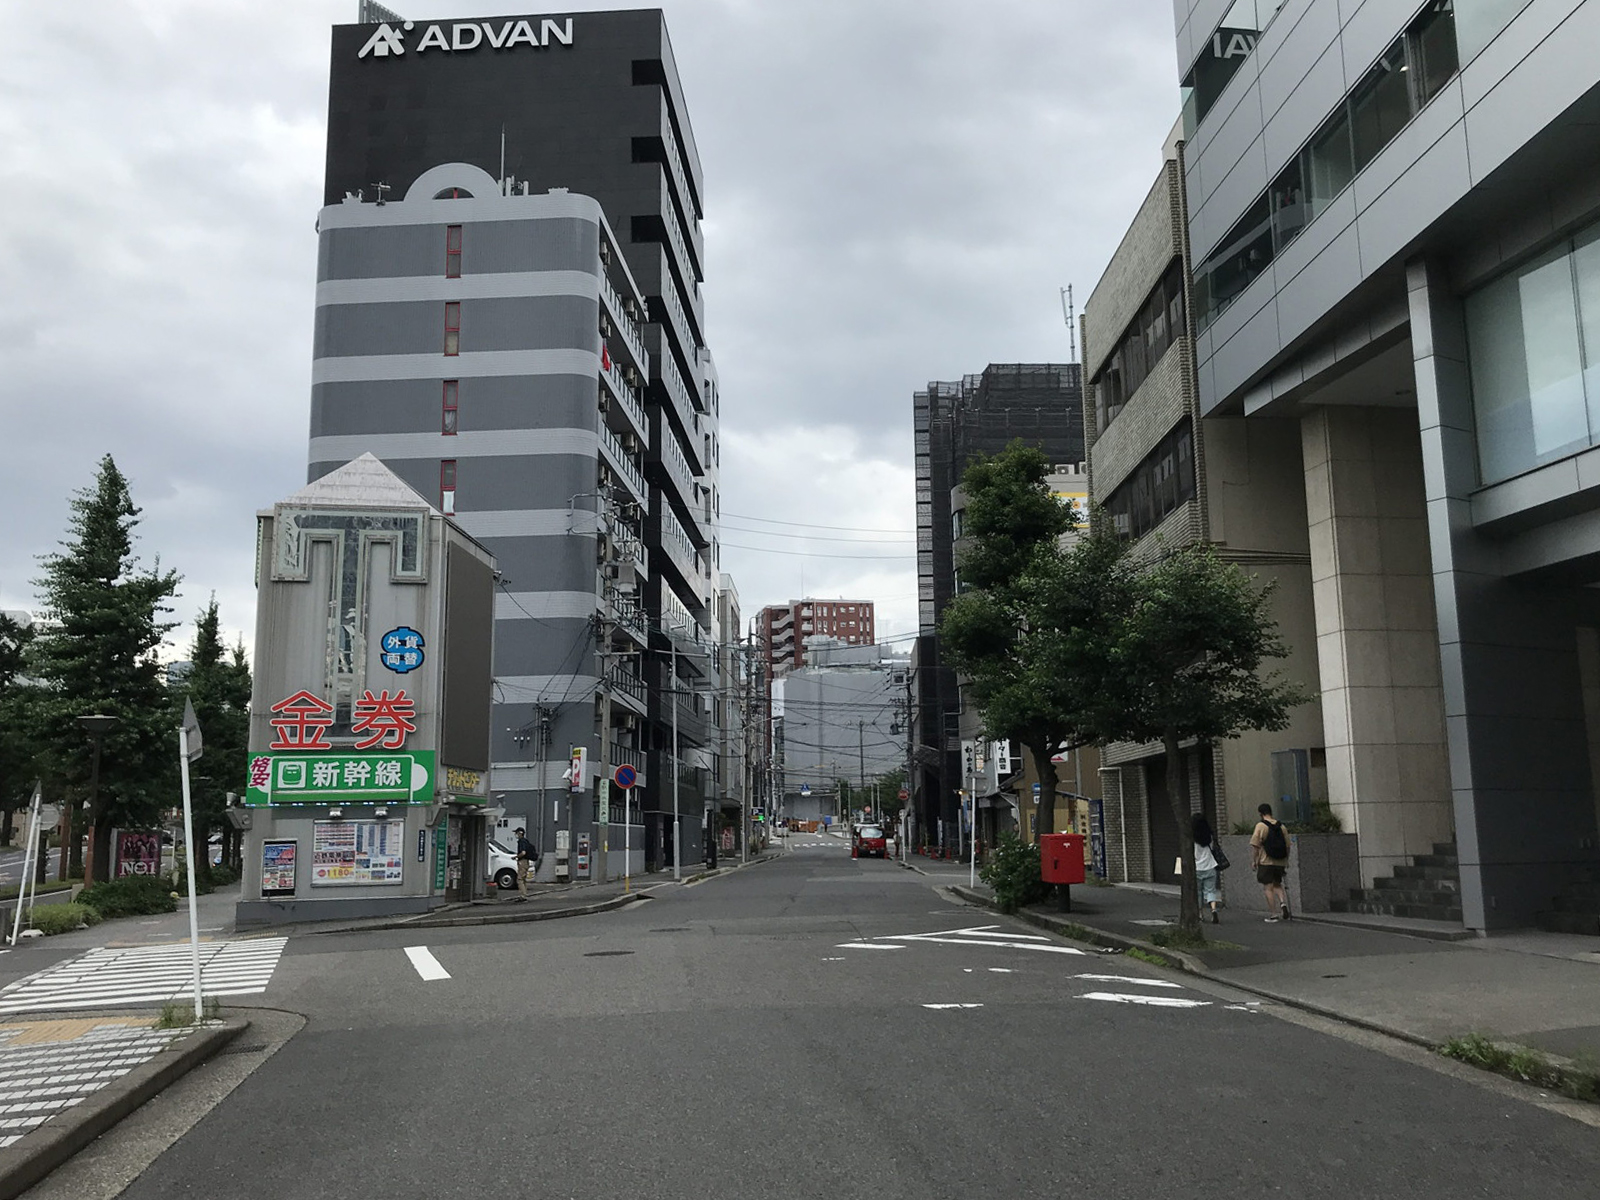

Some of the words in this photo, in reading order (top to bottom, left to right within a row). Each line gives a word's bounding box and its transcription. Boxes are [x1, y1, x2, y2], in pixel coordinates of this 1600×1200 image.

[416, 18, 573, 52] ADVAN
[388, 635, 418, 649] 外貨
[387, 652, 417, 665] 両替
[270, 690, 416, 749] 金券
[250, 756, 270, 787] 格安
[312, 760, 402, 787] 新幹線
